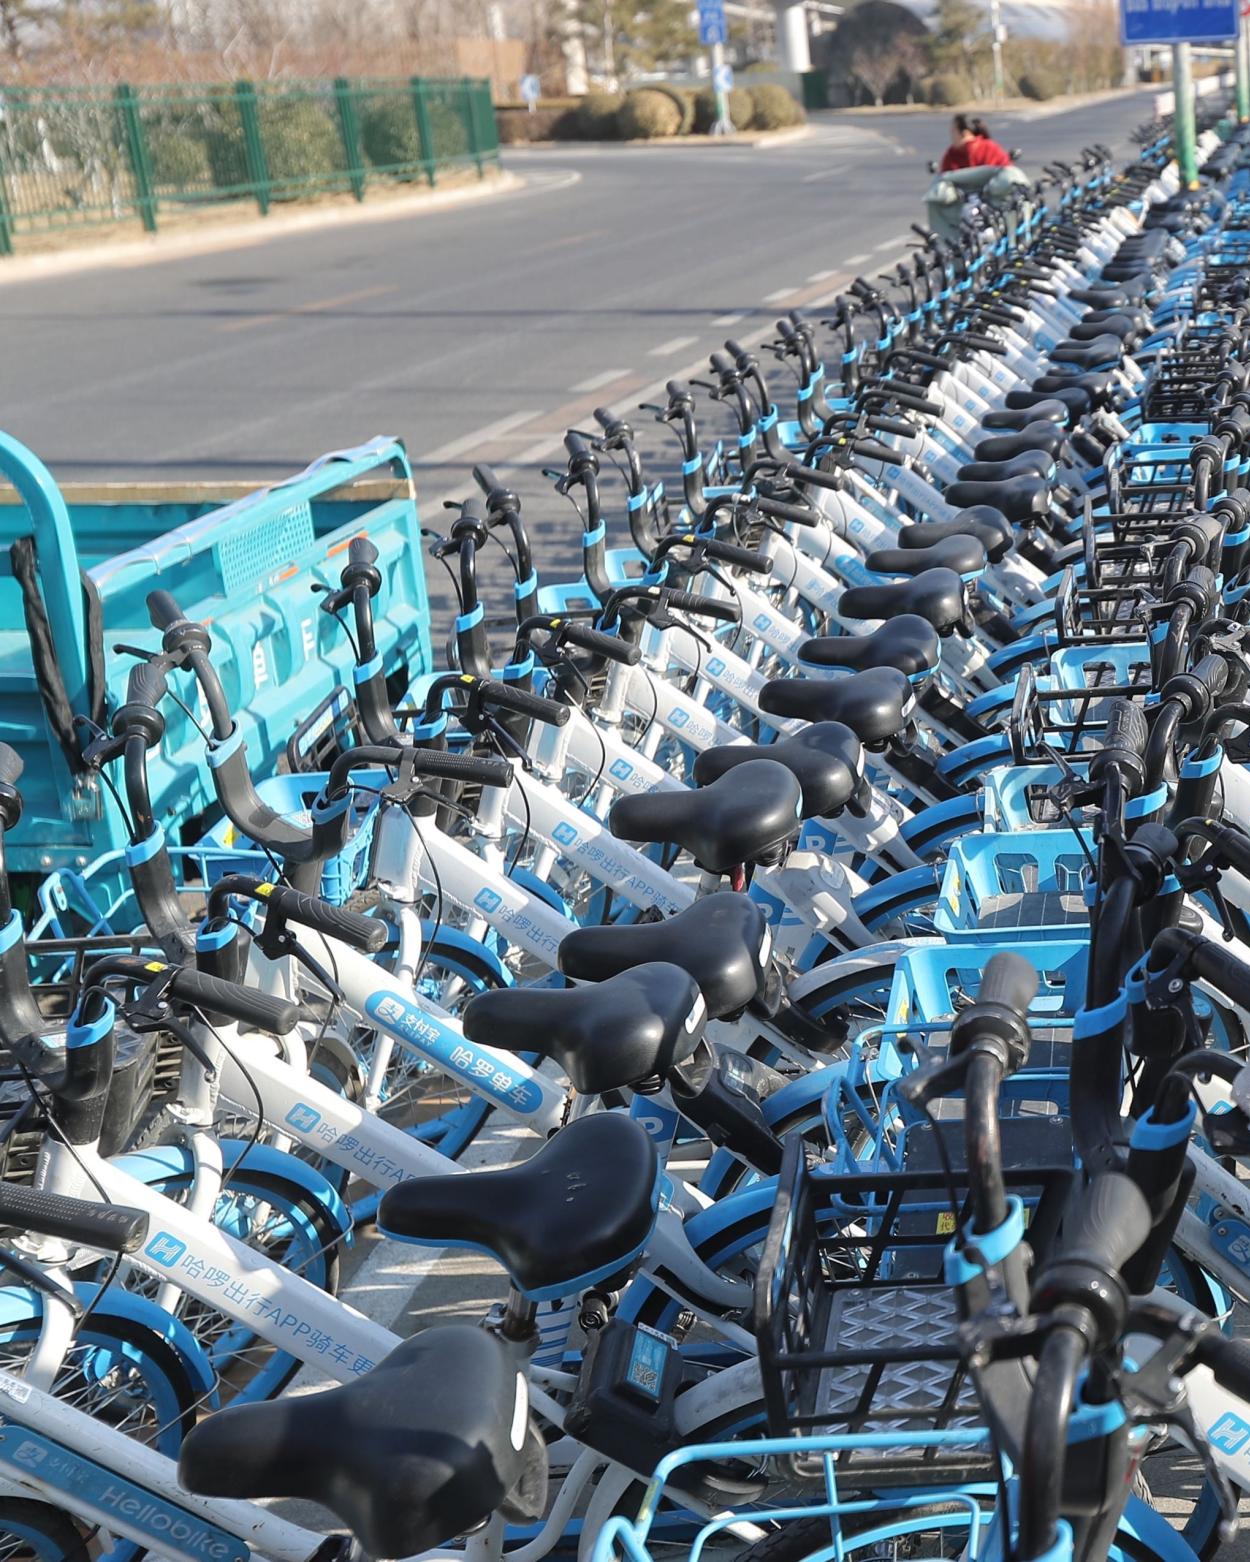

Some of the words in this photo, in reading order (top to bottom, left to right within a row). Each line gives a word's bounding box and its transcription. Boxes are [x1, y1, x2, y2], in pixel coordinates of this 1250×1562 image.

[450, 1046, 532, 1106] 哈罗单车
[100, 1485, 230, 1559] Hellobike
